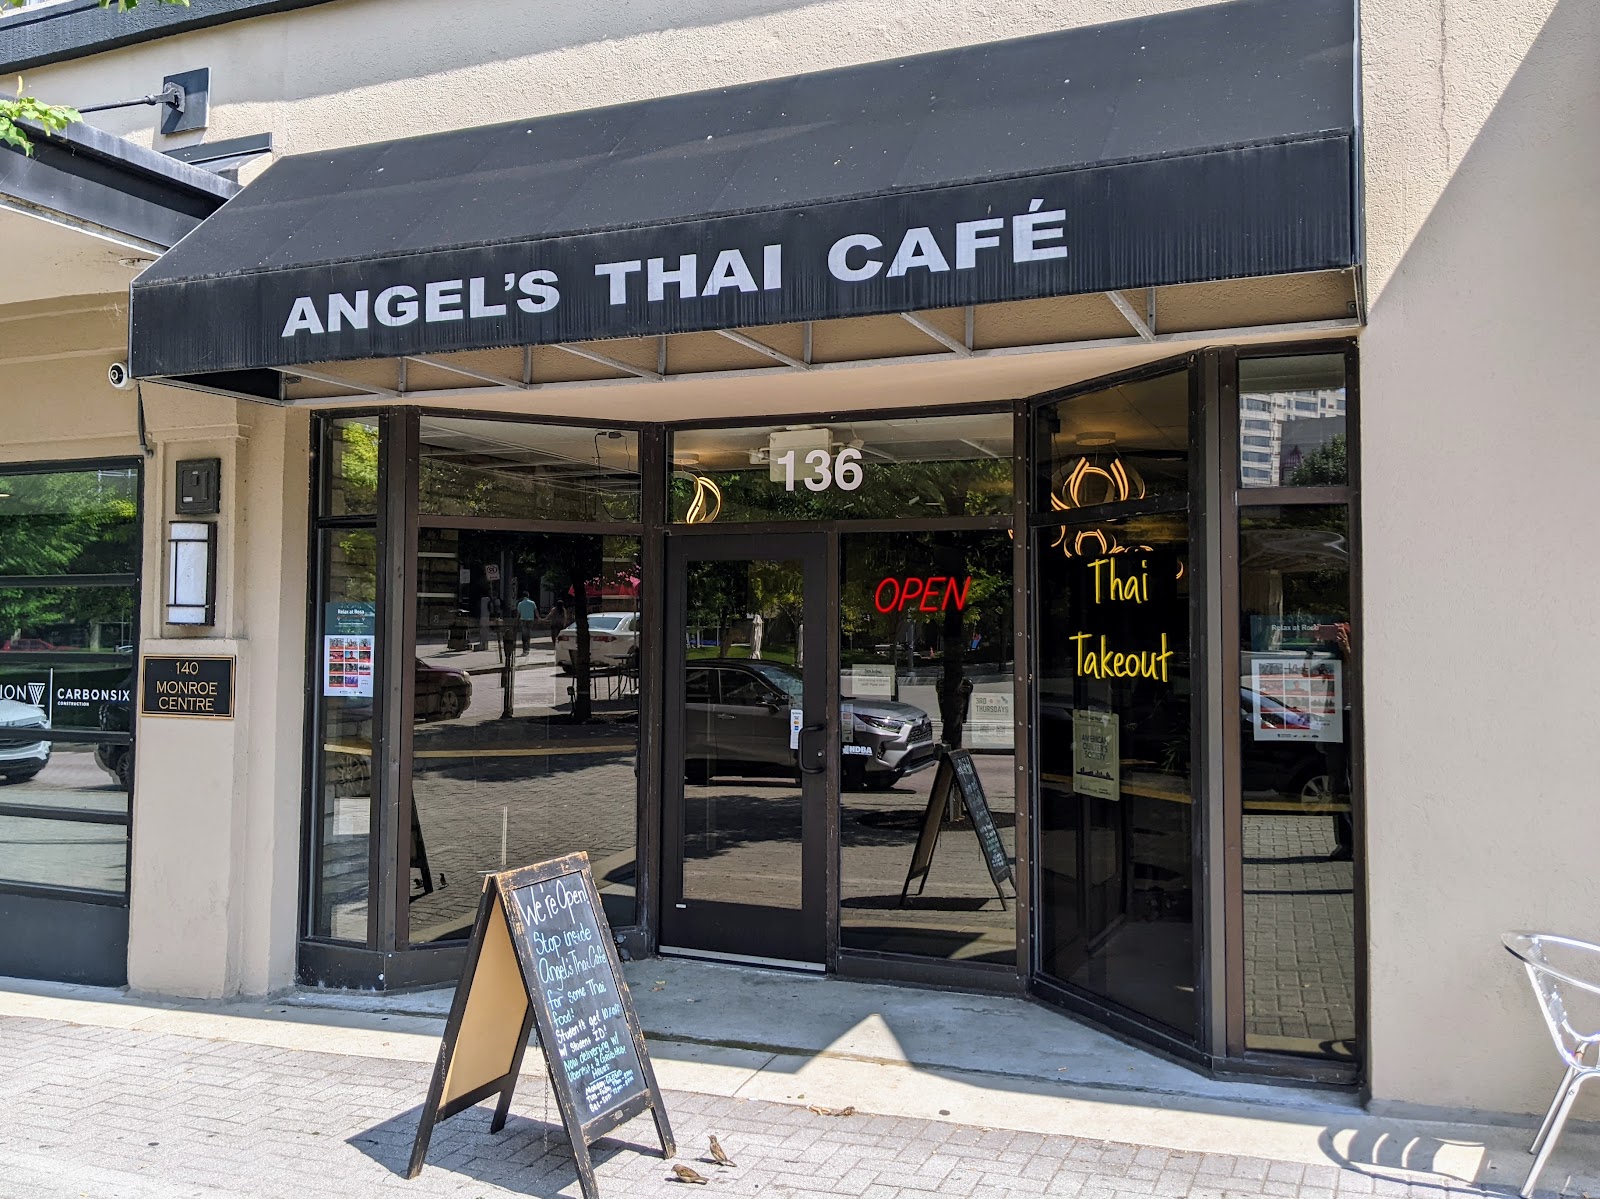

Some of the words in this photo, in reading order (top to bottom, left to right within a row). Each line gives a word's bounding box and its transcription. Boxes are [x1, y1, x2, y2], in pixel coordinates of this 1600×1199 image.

[281, 269, 561, 338] ANGEL'S
[594, 244, 782, 306] THAI
[827, 198, 1069, 282] CAFÉ
[777, 448, 864, 492] 136
[874, 576, 972, 613] OPEN
[1087, 557, 1149, 604] Thai
[176, 661, 199, 675] 140
[1069, 631, 1174, 682] Takeout
[57, 688, 130, 702] CARBONSIX
[156, 681, 218, 695] MONROE
[158, 696, 215, 711] CENTRE
[976, 705, 1009, 713] THURSDAYS
[513, 883, 559, 927] We're
[556, 878, 590, 925] Open!
[533, 931, 562, 958] Stop
[563, 922, 592, 947] inside
[567, 949, 591, 975] Thai
[547, 989, 564, 1010] for
[567, 986, 587, 1004] some
[585, 978, 607, 996] Thai
[552, 1007, 575, 1028] food!
[588, 1009, 601, 1032] get
[592, 1024, 607, 1042] ID!
[563, 1057, 579, 1073] Now
[579, 1041, 611, 1064] delivering
